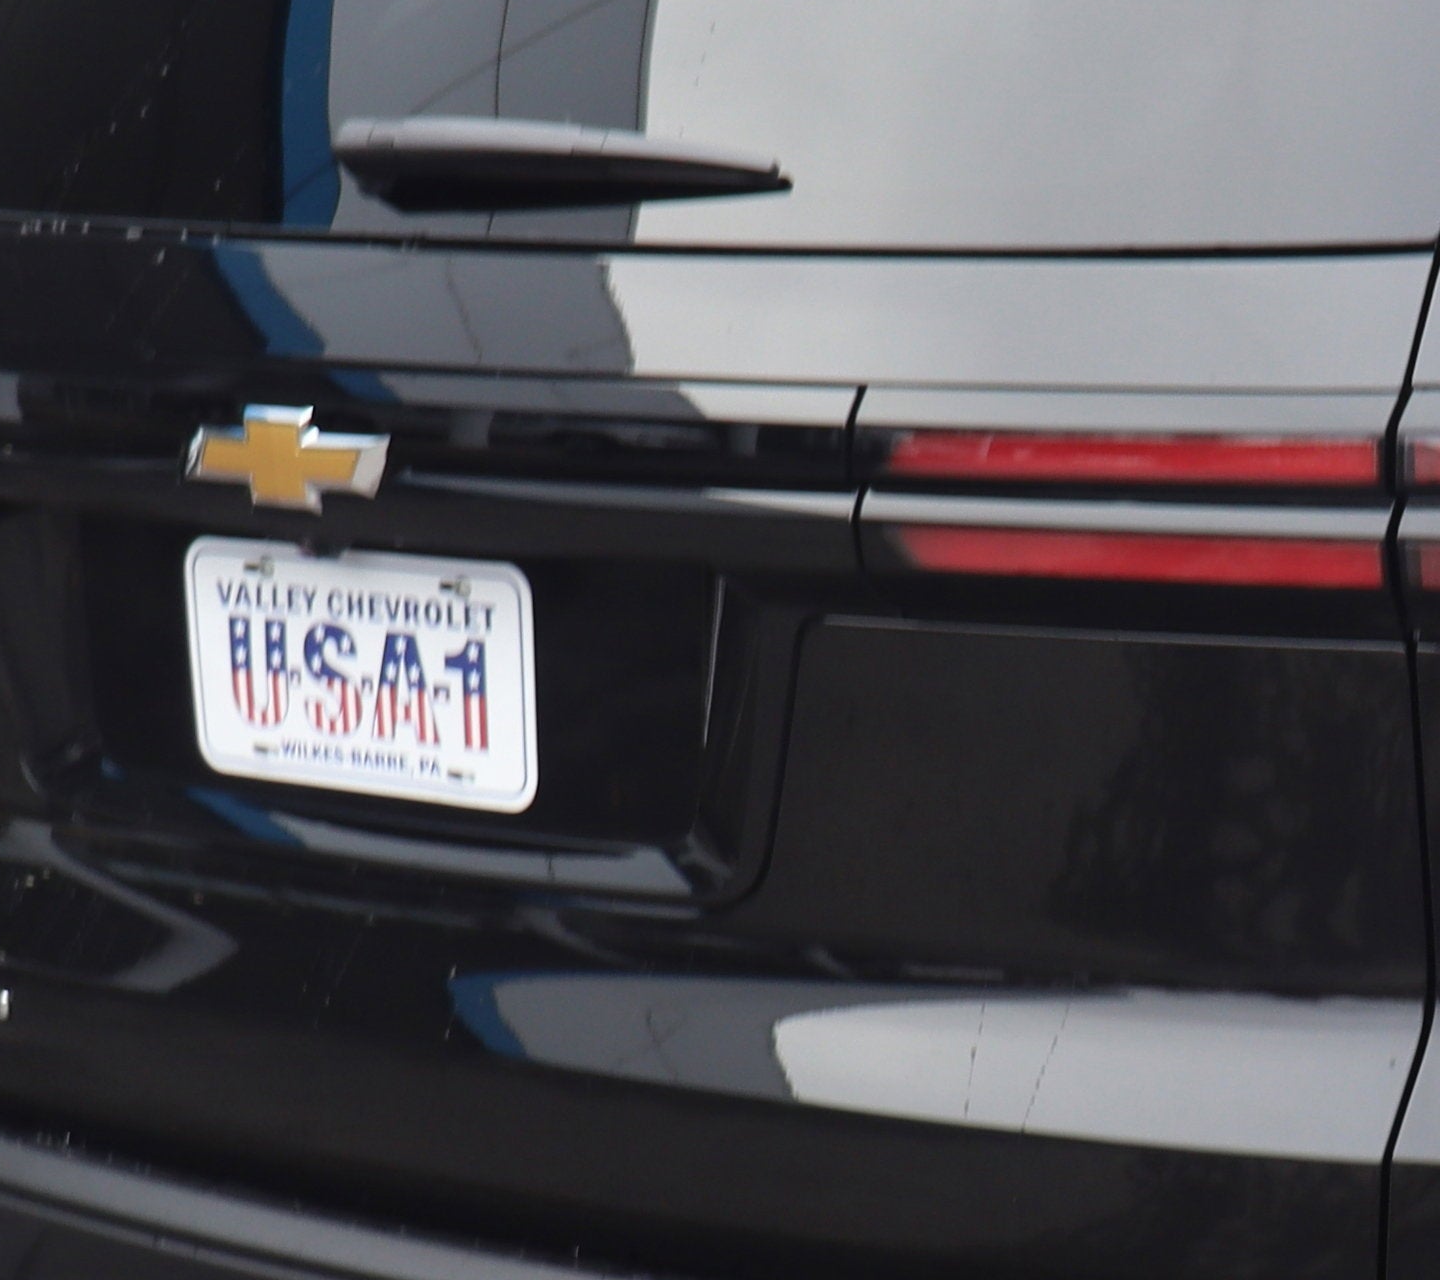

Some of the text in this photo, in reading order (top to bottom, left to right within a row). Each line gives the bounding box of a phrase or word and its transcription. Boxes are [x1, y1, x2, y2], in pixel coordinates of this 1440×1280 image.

[216, 578, 495, 631] VALLEY CHEVROLET
[418, 756, 441, 777] PA
